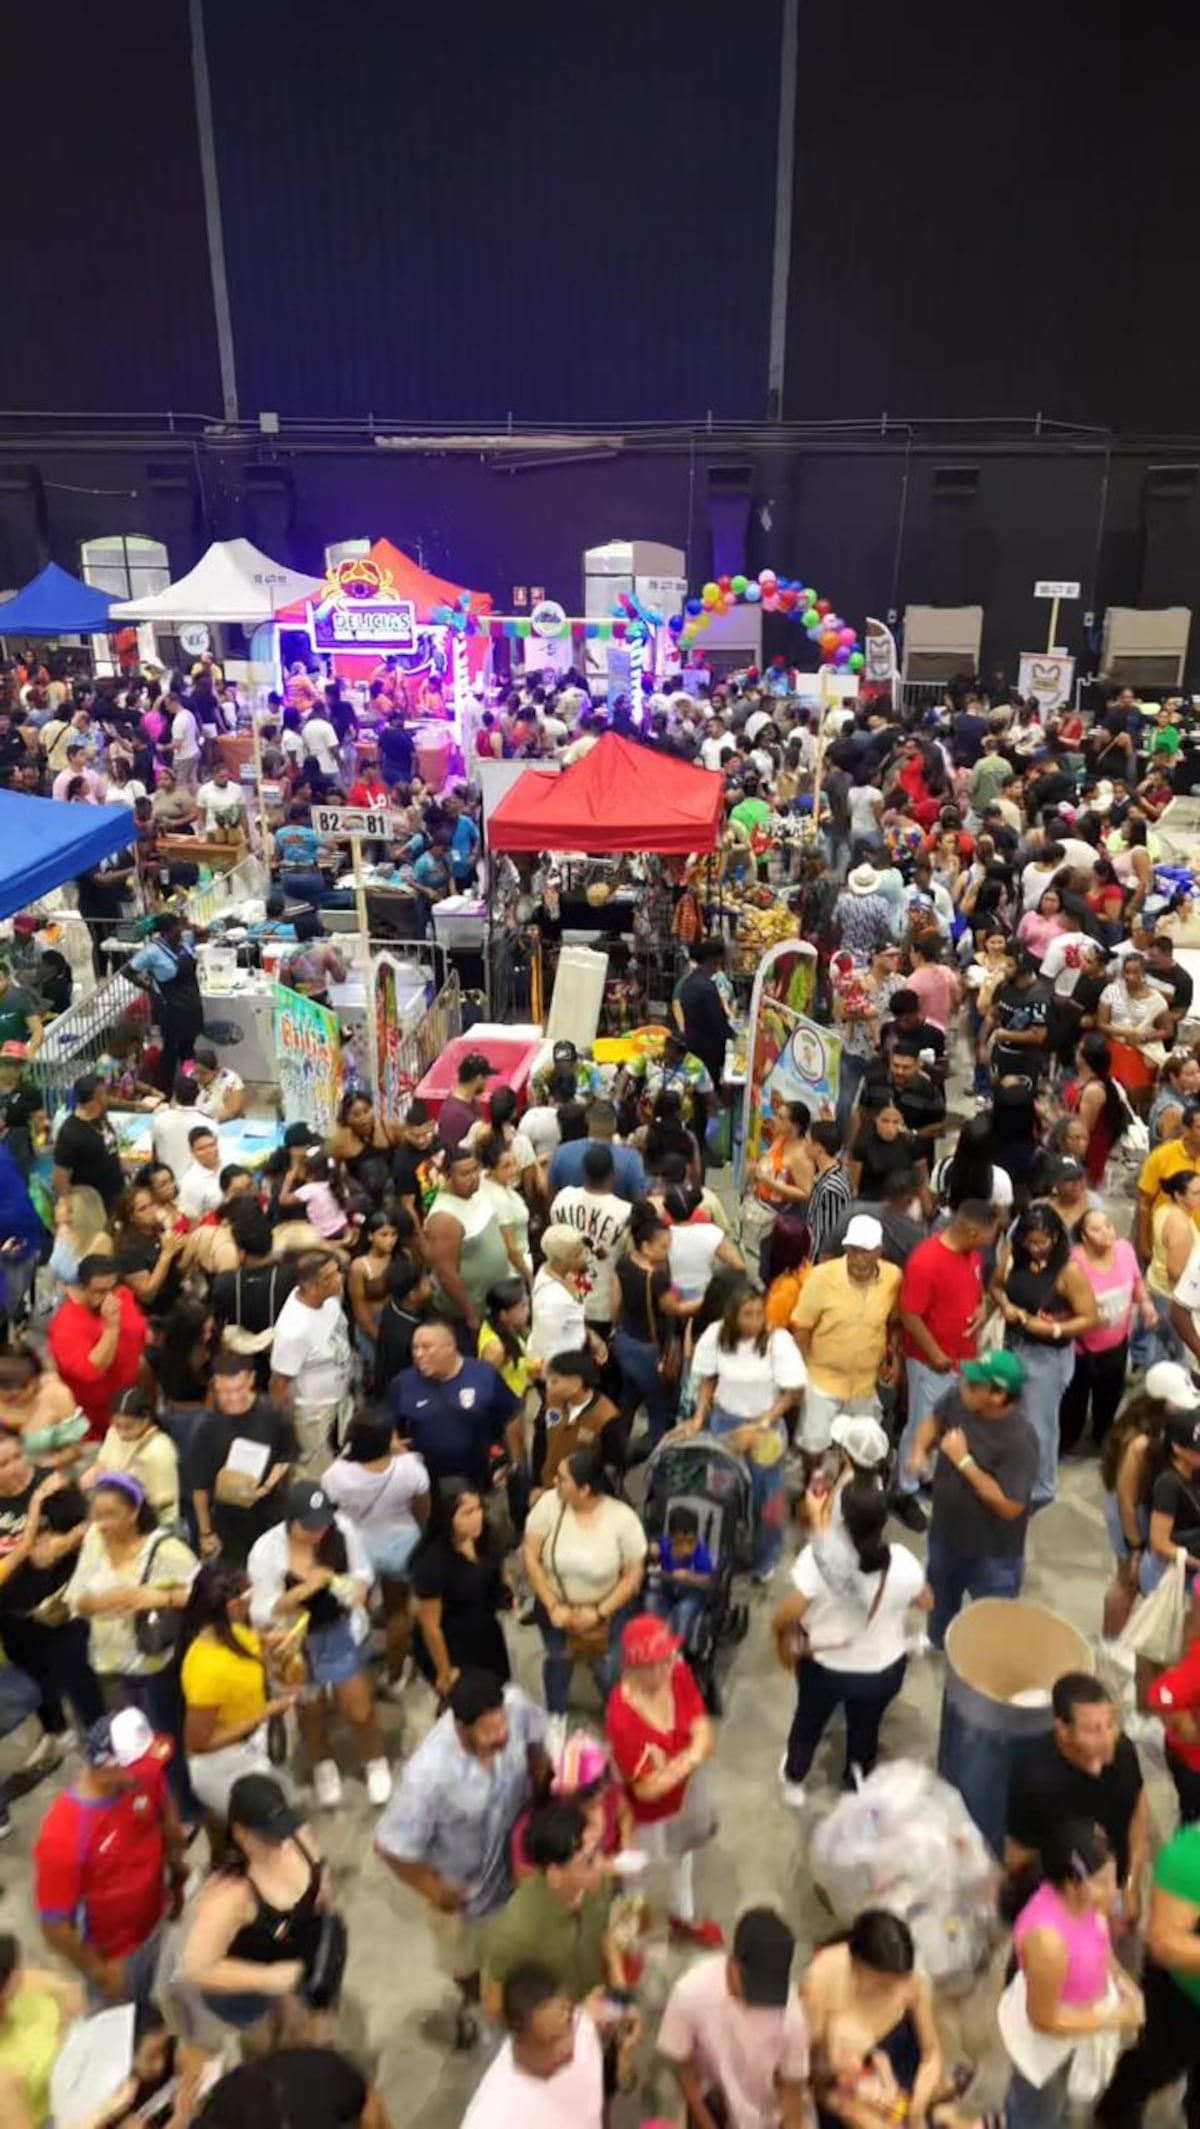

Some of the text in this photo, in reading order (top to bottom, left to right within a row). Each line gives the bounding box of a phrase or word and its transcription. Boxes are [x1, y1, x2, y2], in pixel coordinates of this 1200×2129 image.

[334, 613, 410, 629] DELICIAS
[320, 812, 385, 834] 82 81
